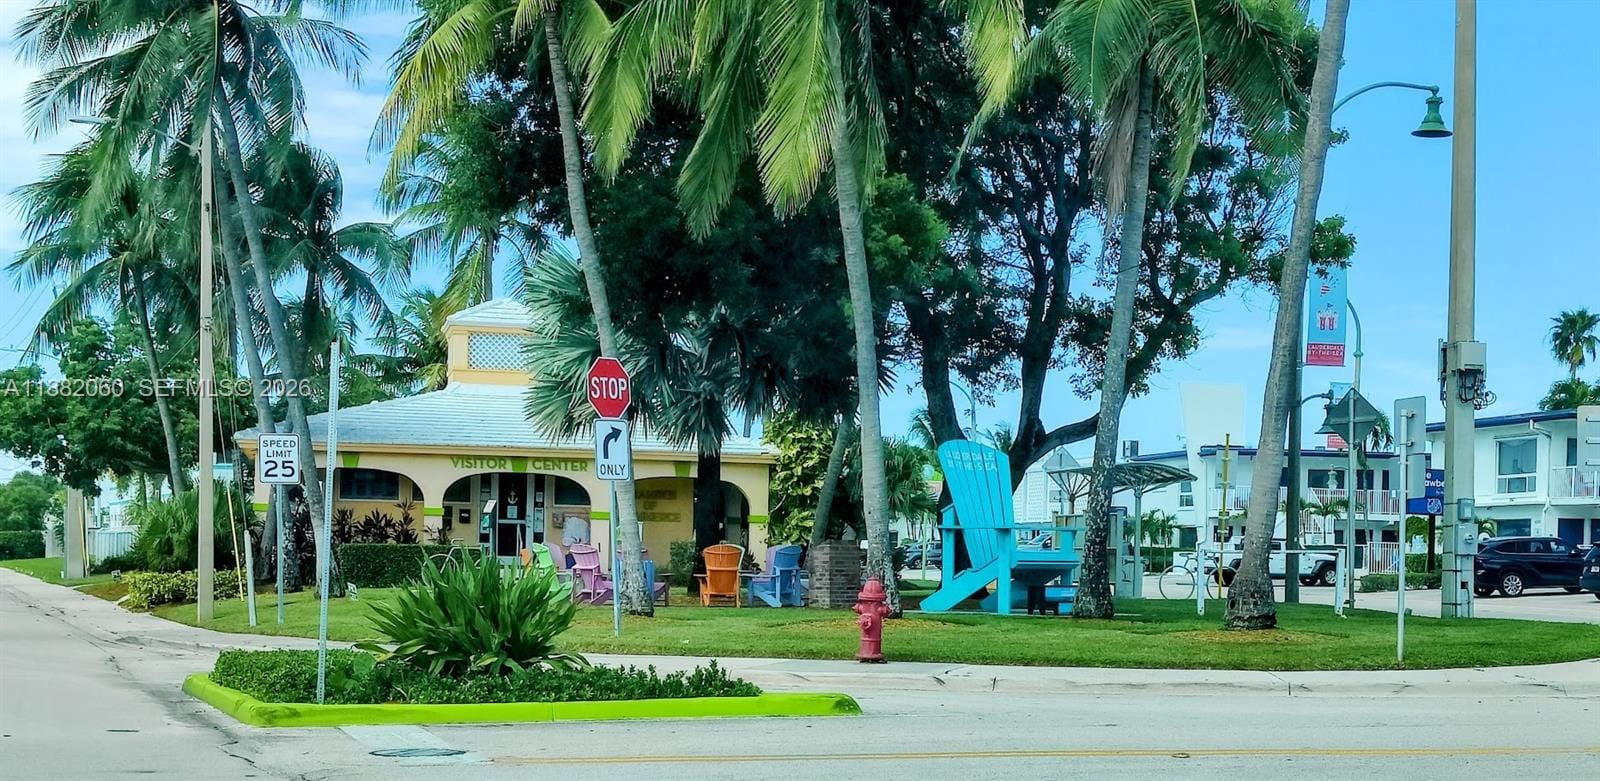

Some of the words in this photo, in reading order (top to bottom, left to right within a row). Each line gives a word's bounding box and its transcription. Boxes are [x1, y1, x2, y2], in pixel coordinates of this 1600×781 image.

[591, 377, 627, 400] STOP
[262, 440, 296, 448] SPEED
[264, 460, 295, 477] 25
[450, 456, 507, 469] VISITOR
[532, 458, 588, 472] CENTER
[600, 464, 626, 476] ONLY
